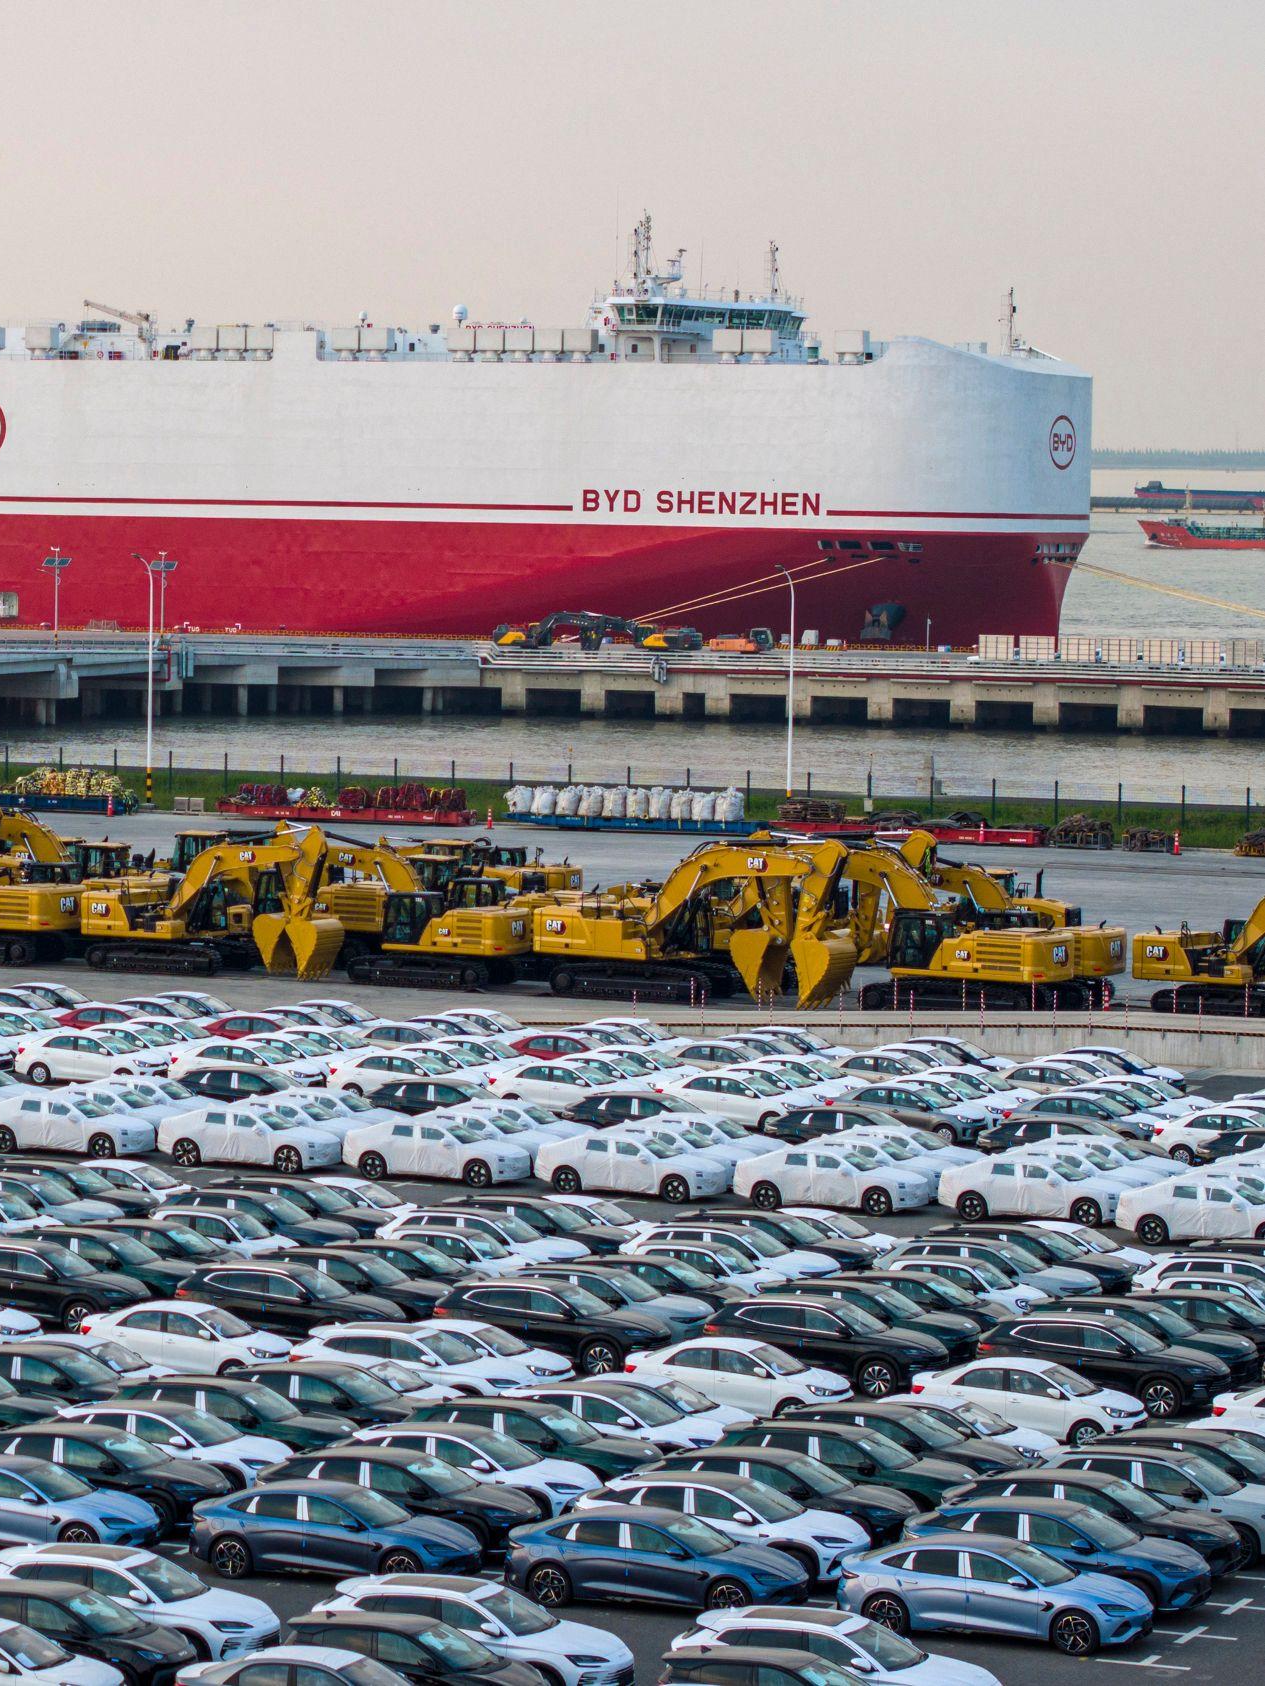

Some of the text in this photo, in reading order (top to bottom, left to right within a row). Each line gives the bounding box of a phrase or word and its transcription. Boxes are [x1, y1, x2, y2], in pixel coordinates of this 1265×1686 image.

[1052, 432, 1074, 452] BYD
[582, 489, 821, 517] BYD SHENZHEN
[238, 850, 253, 862] CAT
[338, 851, 354, 864] CAT
[746, 856, 764, 870] CAT
[59, 895, 75, 913] CAT
[90, 902, 107, 914] CAT
[313, 902, 327, 911] CAT
[438, 927, 449, 935] CAT
[511, 919, 524, 937] CAT
[545, 919, 563, 932] CAT
[954, 949, 969, 960] CAT
[1052, 945, 1067, 964] CAT
[1145, 945, 1165, 958] CAT
